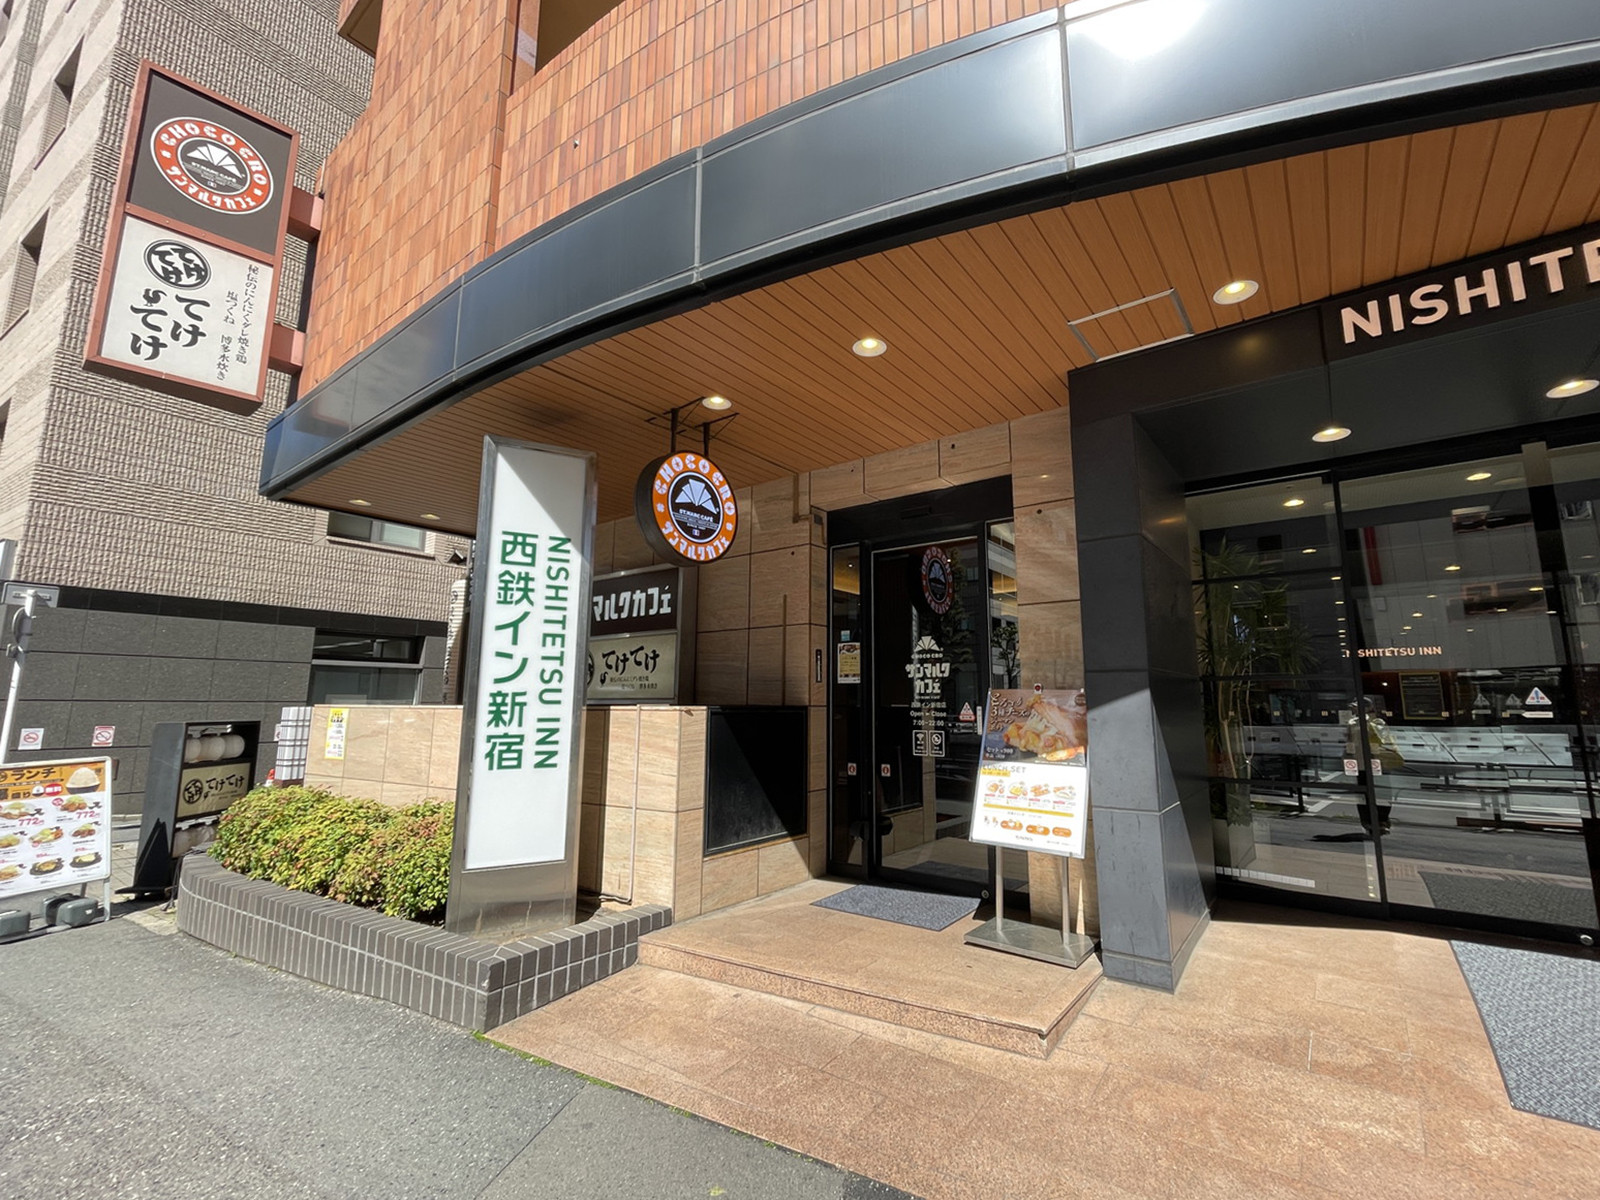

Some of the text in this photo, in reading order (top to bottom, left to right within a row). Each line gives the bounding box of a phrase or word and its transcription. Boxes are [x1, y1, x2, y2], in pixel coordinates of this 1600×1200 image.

[160, 122, 236, 146] CHOCO
[238, 147, 267, 185] CRO
[166, 165, 256, 210] サンマルクカフェ
[216, 334, 232, 381] 博多水炊き
[654, 454, 735, 515] CHOCO CRO
[661, 520, 729, 560] サンマルクカフェ
[484, 530, 540, 772] 西鉄イン新宿
[533, 535, 572, 770] NISHITETSU INN
[602, 645, 660, 676] てけてけ
[905, 662, 950, 678] サンマルク
[1419, 646, 1442, 656] INN
[915, 679, 941, 694] カフェ
[11, 767, 56, 781] ランチ
[206, 774, 245, 792] てけてけ
